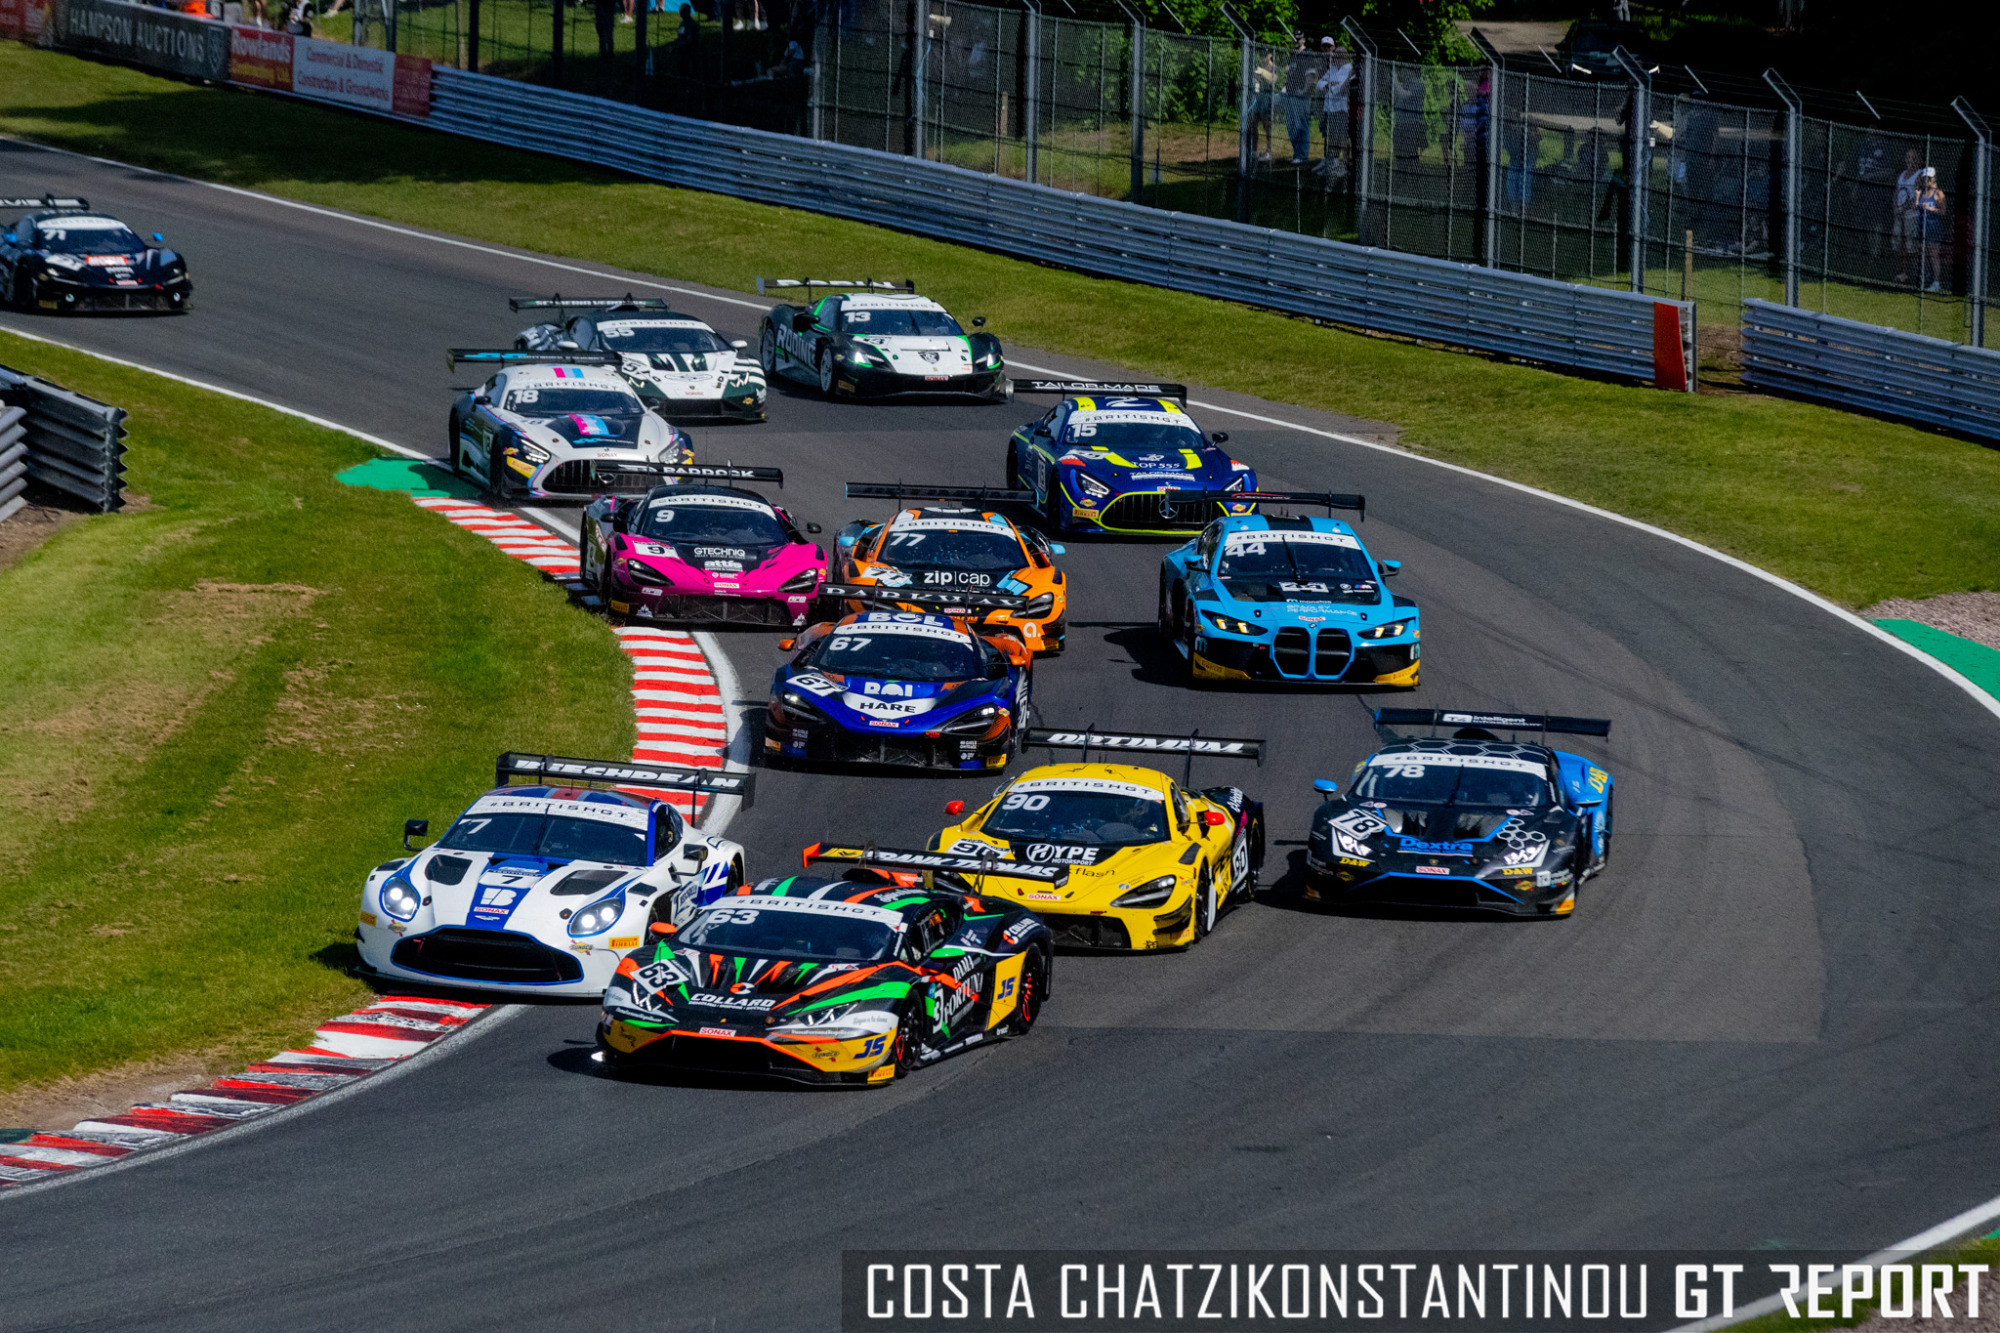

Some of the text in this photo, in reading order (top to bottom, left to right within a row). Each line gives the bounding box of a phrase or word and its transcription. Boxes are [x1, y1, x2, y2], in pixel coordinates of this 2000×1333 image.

[71, 9, 132, 47] HAMPSON
[136, 21, 205, 62] AUCTIONS
[231, 29, 291, 63] Rowlands
[844, 311, 871, 323] 13
[603, 328, 636, 339] 55
[1031, 381, 1164, 394] TAILOR-MADE
[513, 390, 540, 404] 18
[1070, 424, 1097, 438] 15
[660, 465, 758, 478] PADDOCK
[1132, 461, 1157, 469] TOP
[655, 509, 675, 523] 9
[889, 532, 927, 547] 77
[647, 545, 666, 555] 9
[694, 547, 746, 557] GTECHNIQ
[1225, 543, 1267, 557] 44
[829, 636, 873, 652] 67
[796, 675, 837, 692] 67
[859, 702, 917, 714] HARE
[1047, 733, 1244, 755] OPTIMUM
[1381, 764, 1425, 779] 78
[1017, 782, 1151, 797] #BRITISHGT
[491, 800, 630, 819] #BRITISHGT
[1000, 794, 1051, 812] 90
[460, 818, 494, 835] 7
[1339, 810, 1380, 833] 78
[1399, 838, 1474, 850] Dextra
[1051, 858, 1094, 867] MOTORSPORT
[1417, 866, 1448, 874] SONAX
[501, 874, 525, 885] 7
[1027, 893, 1059, 901] SONAX
[475, 906, 508, 914] SONAX
[737, 896, 883, 917] #BRITISHGT
[706, 908, 760, 925] 63
[611, 939, 640, 950] PIRELLI
[639, 961, 680, 989] 63
[997, 976, 1017, 1001] JS
[690, 993, 777, 1009] COLLARD
[700, 1028, 734, 1037] SONAX
[853, 1035, 889, 1060] JS
